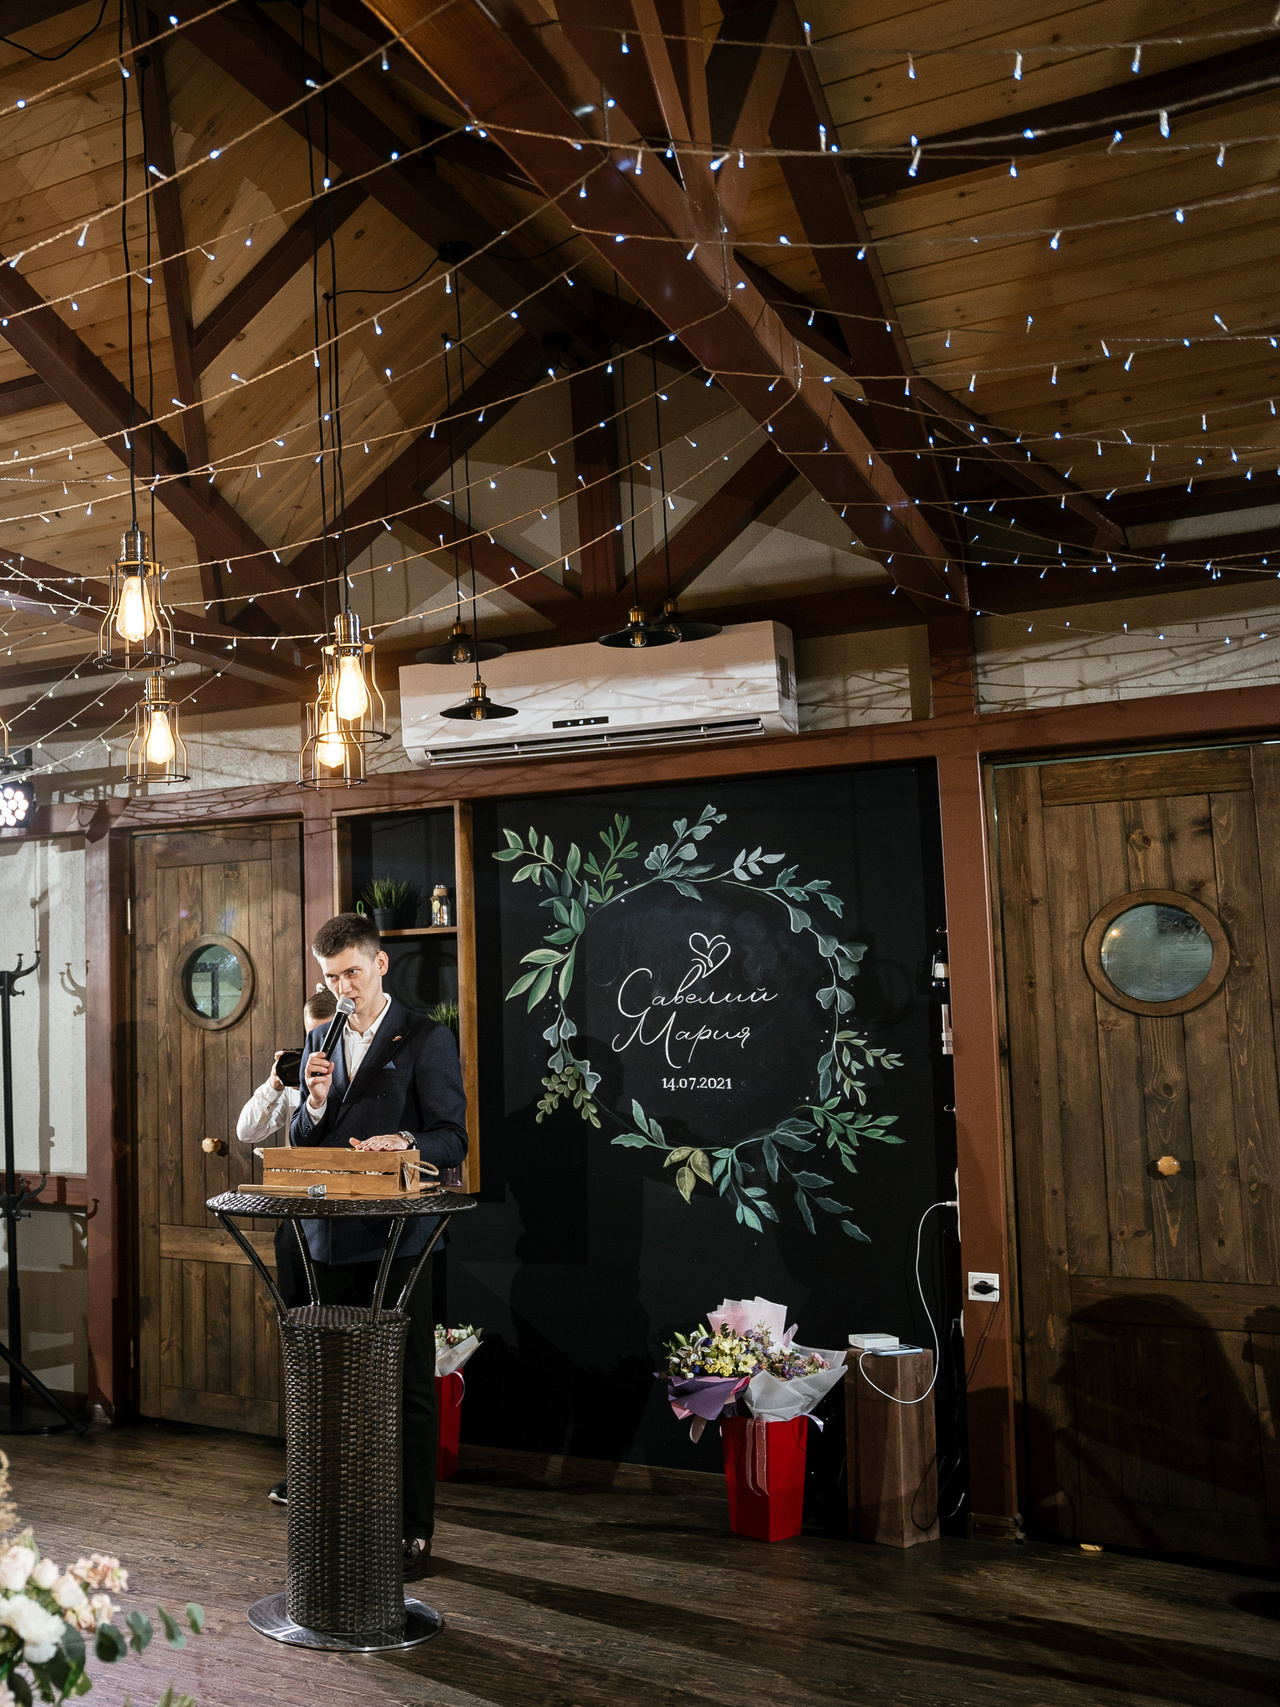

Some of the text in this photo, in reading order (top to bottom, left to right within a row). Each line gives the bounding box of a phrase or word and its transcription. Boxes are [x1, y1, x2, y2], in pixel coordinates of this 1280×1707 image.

[617, 963, 778, 1018] Савелий
[612, 1010, 751, 1069] Мария
[661, 1076, 733, 1091] 14.07.2021
